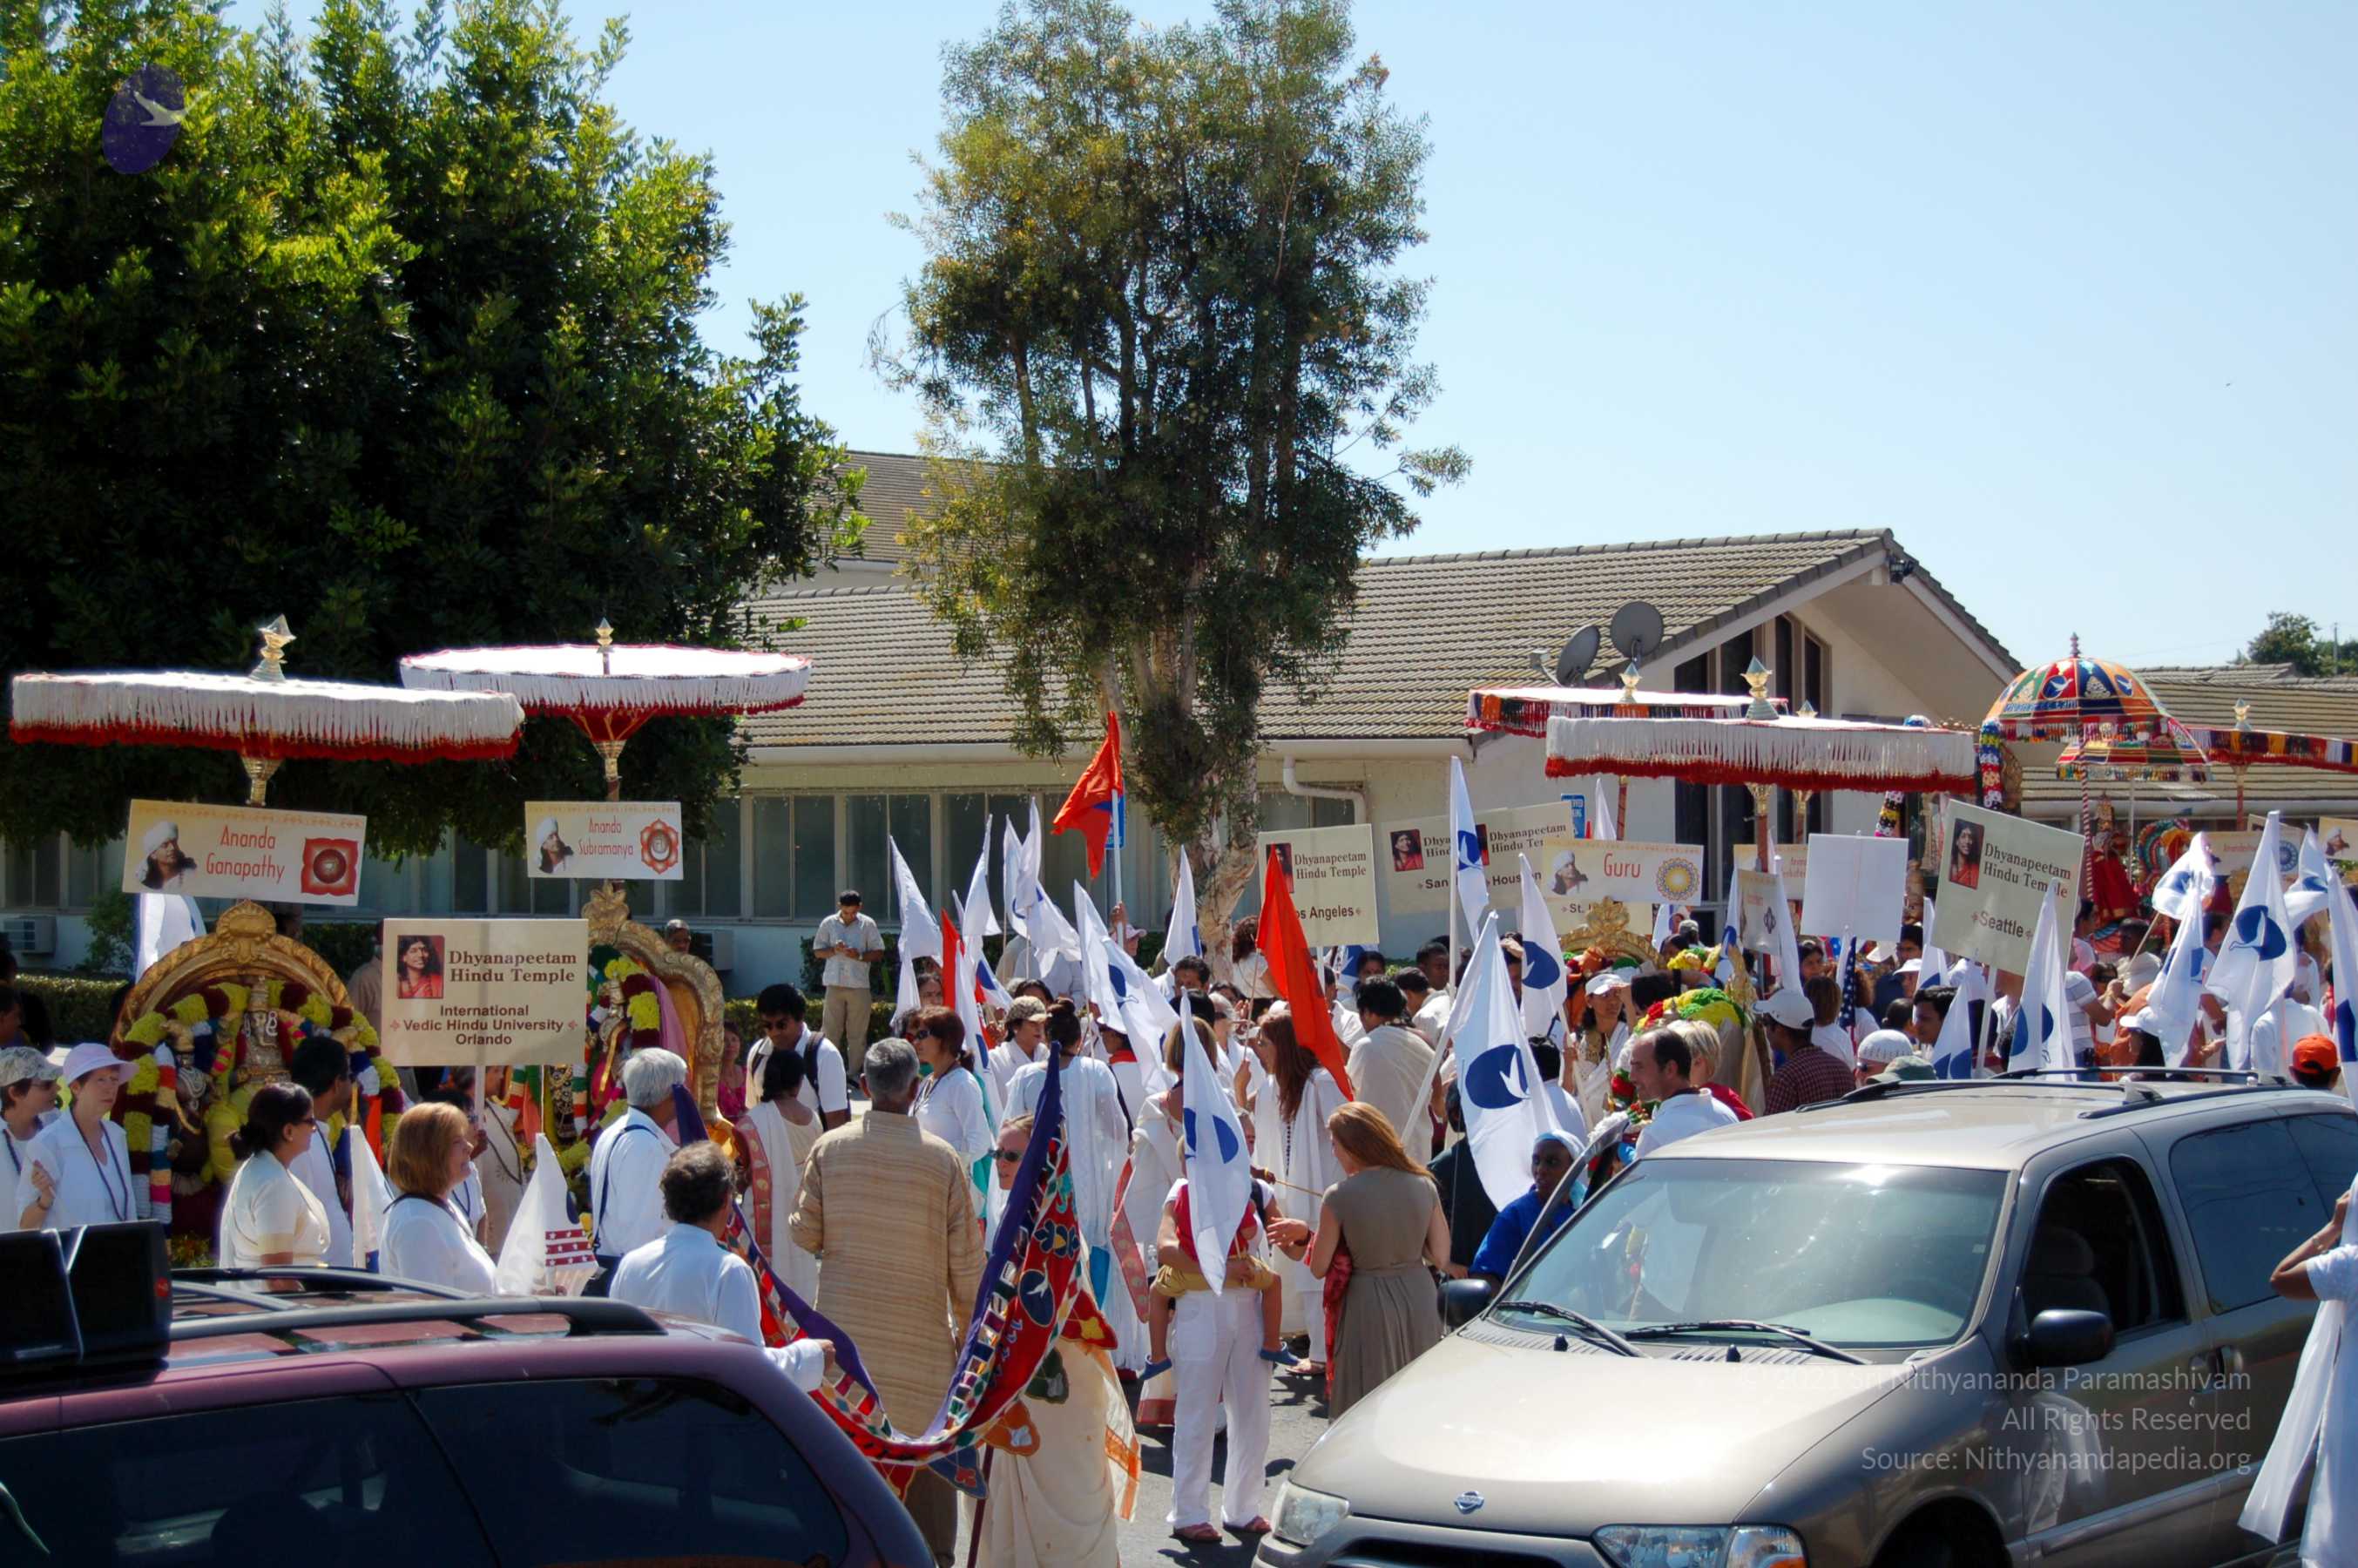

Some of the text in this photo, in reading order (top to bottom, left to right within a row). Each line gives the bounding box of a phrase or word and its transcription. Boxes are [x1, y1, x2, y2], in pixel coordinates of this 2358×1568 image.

[589, 815, 621, 834] Ananda
[1490, 823, 1566, 841] Dhyanapeetam
[220, 825, 275, 849] Ananda
[578, 839, 633, 859] Subramanya
[1491, 841, 1524, 853] Hindu
[1294, 852, 1366, 867] Dhyanapeetam
[1604, 852, 1641, 878] Guru
[1985, 842, 2071, 880] Dhyanapeetam
[206, 853, 285, 883] Ganapathy
[1296, 866, 1366, 879] Hindu Temple
[1425, 879, 1449, 889] San
[1492, 871, 1542, 886] Housn
[1983, 862, 2068, 898] Hindu Temle
[1309, 905, 1354, 921] Angeles
[1979, 910, 2024, 937] Seattle
[449, 950, 577, 967] Dhyanapeetam
[450, 969, 575, 984] Hindu Temple
[440, 1004, 529, 1017] International
[403, 1019, 564, 1033] Vedic Hindu University
[456, 1033, 512, 1045] Orlando
